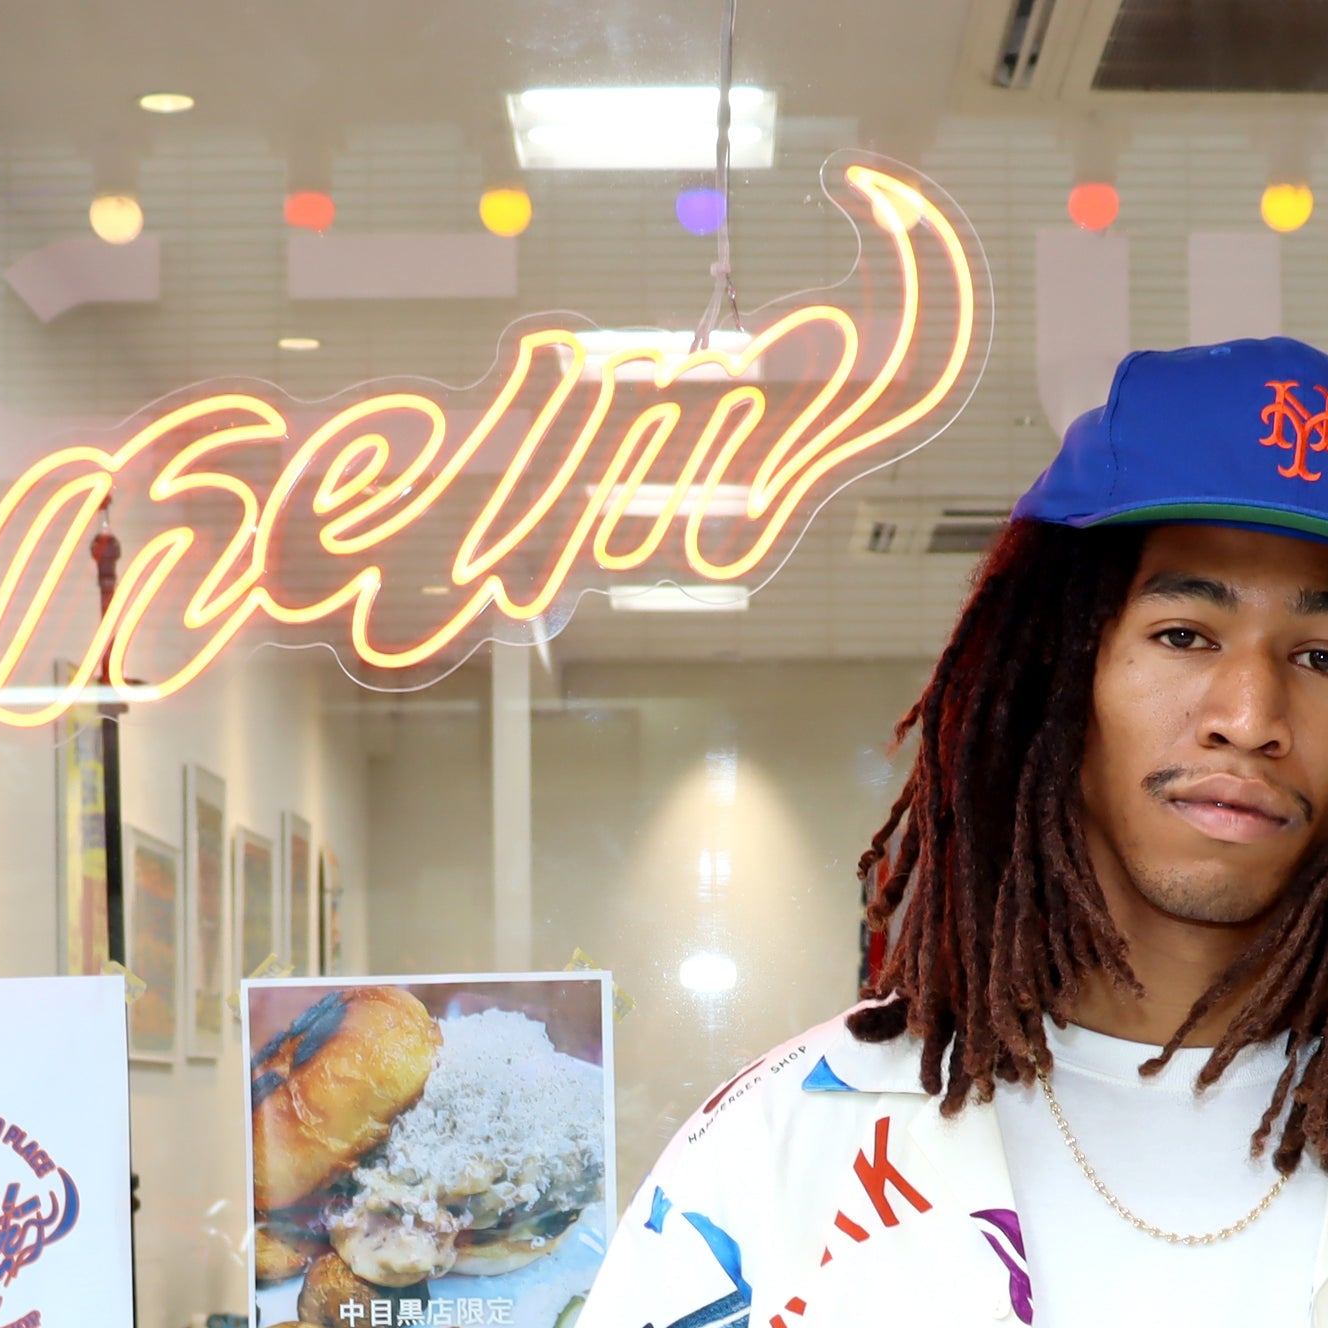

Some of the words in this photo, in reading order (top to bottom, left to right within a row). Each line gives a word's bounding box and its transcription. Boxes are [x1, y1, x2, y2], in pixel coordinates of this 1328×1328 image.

[770, 1045, 807, 1075] SHOP
[3, 1124, 57, 1179] PLACE
[339, 1297, 515, 1328] 中目黒店限定
